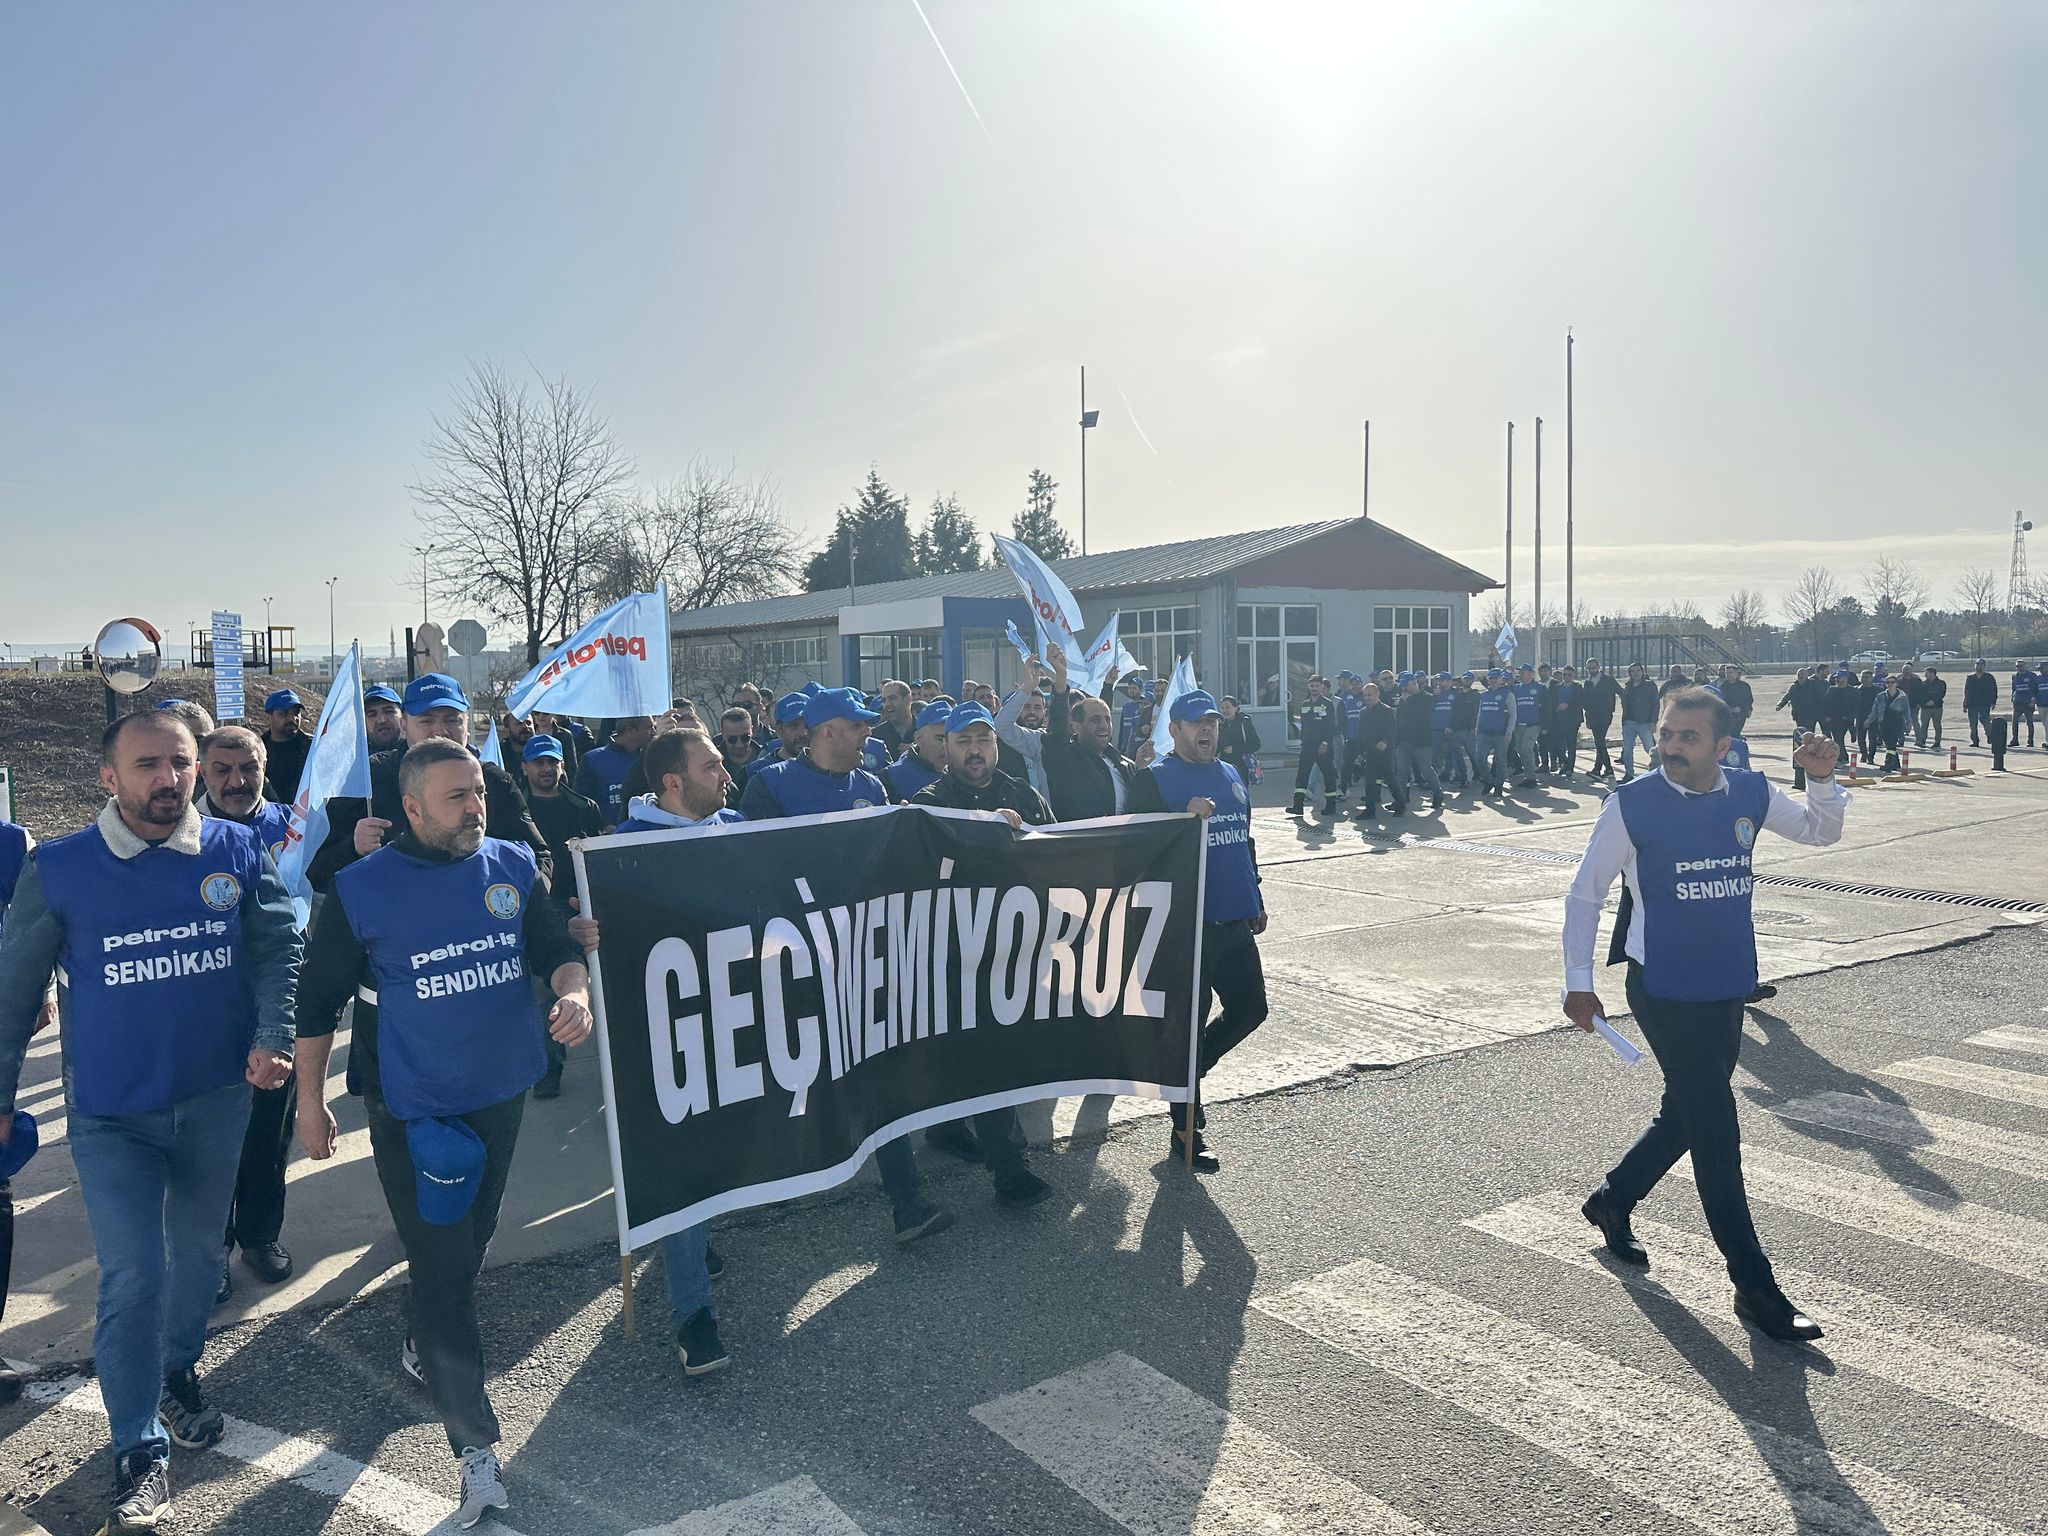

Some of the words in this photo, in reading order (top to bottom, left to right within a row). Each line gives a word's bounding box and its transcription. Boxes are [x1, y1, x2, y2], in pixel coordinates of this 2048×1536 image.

[1675, 855, 1750, 874] petrol-iş
[103, 920, 227, 952] petrol-iş
[410, 932, 517, 970] petrol-iş
[104, 945, 232, 986] SENDİKASI
[415, 956, 523, 1000] SENDİKASI
[645, 857, 1173, 1125] GEÇİNEMİYORUZ
